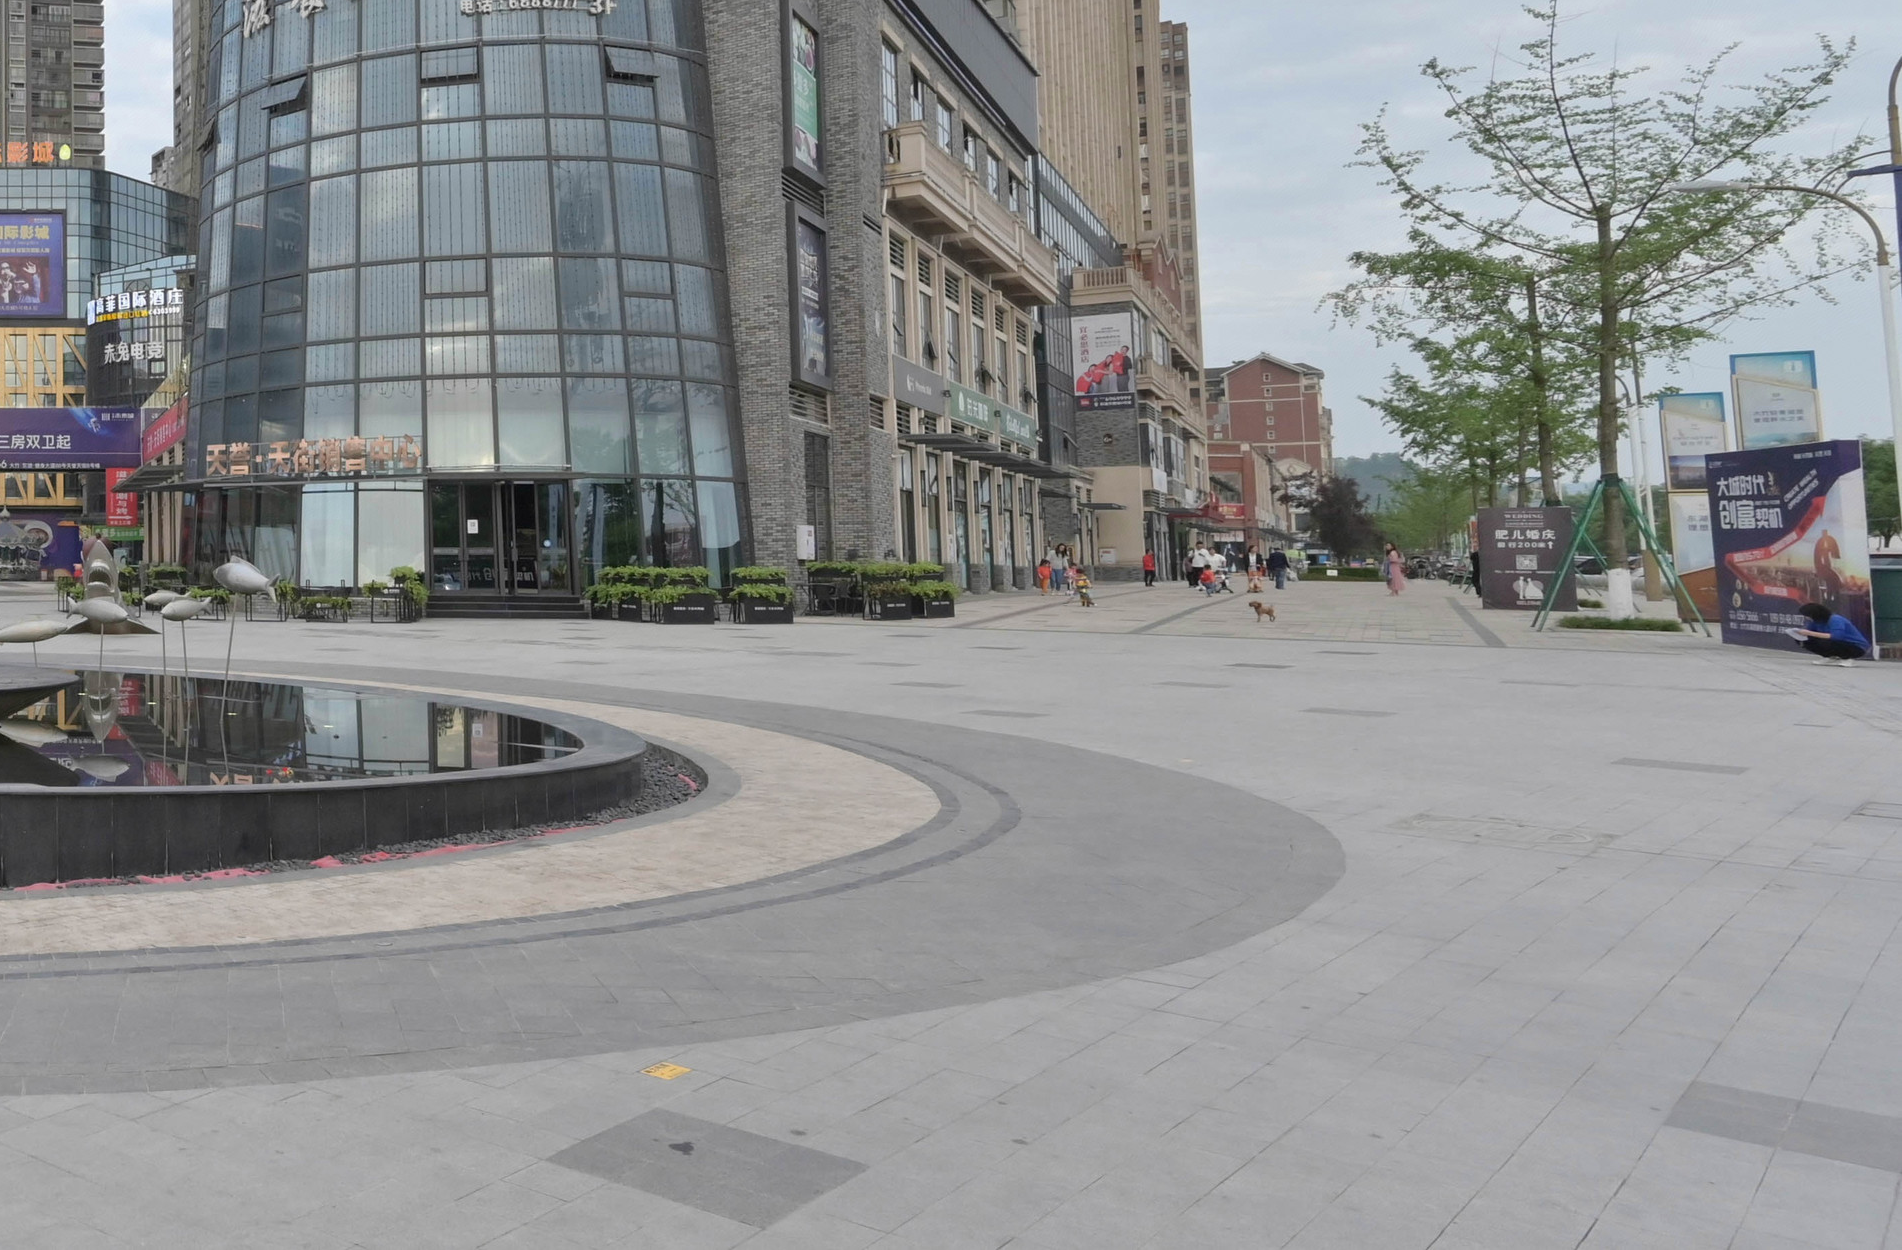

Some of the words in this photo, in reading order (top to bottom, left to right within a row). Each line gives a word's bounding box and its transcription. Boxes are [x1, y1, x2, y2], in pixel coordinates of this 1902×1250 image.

[206, 434, 422, 475] 天誉·天街销售中心
[1716, 474, 1765, 497] 大城时代
[1719, 499, 1783, 529] 创富契机
